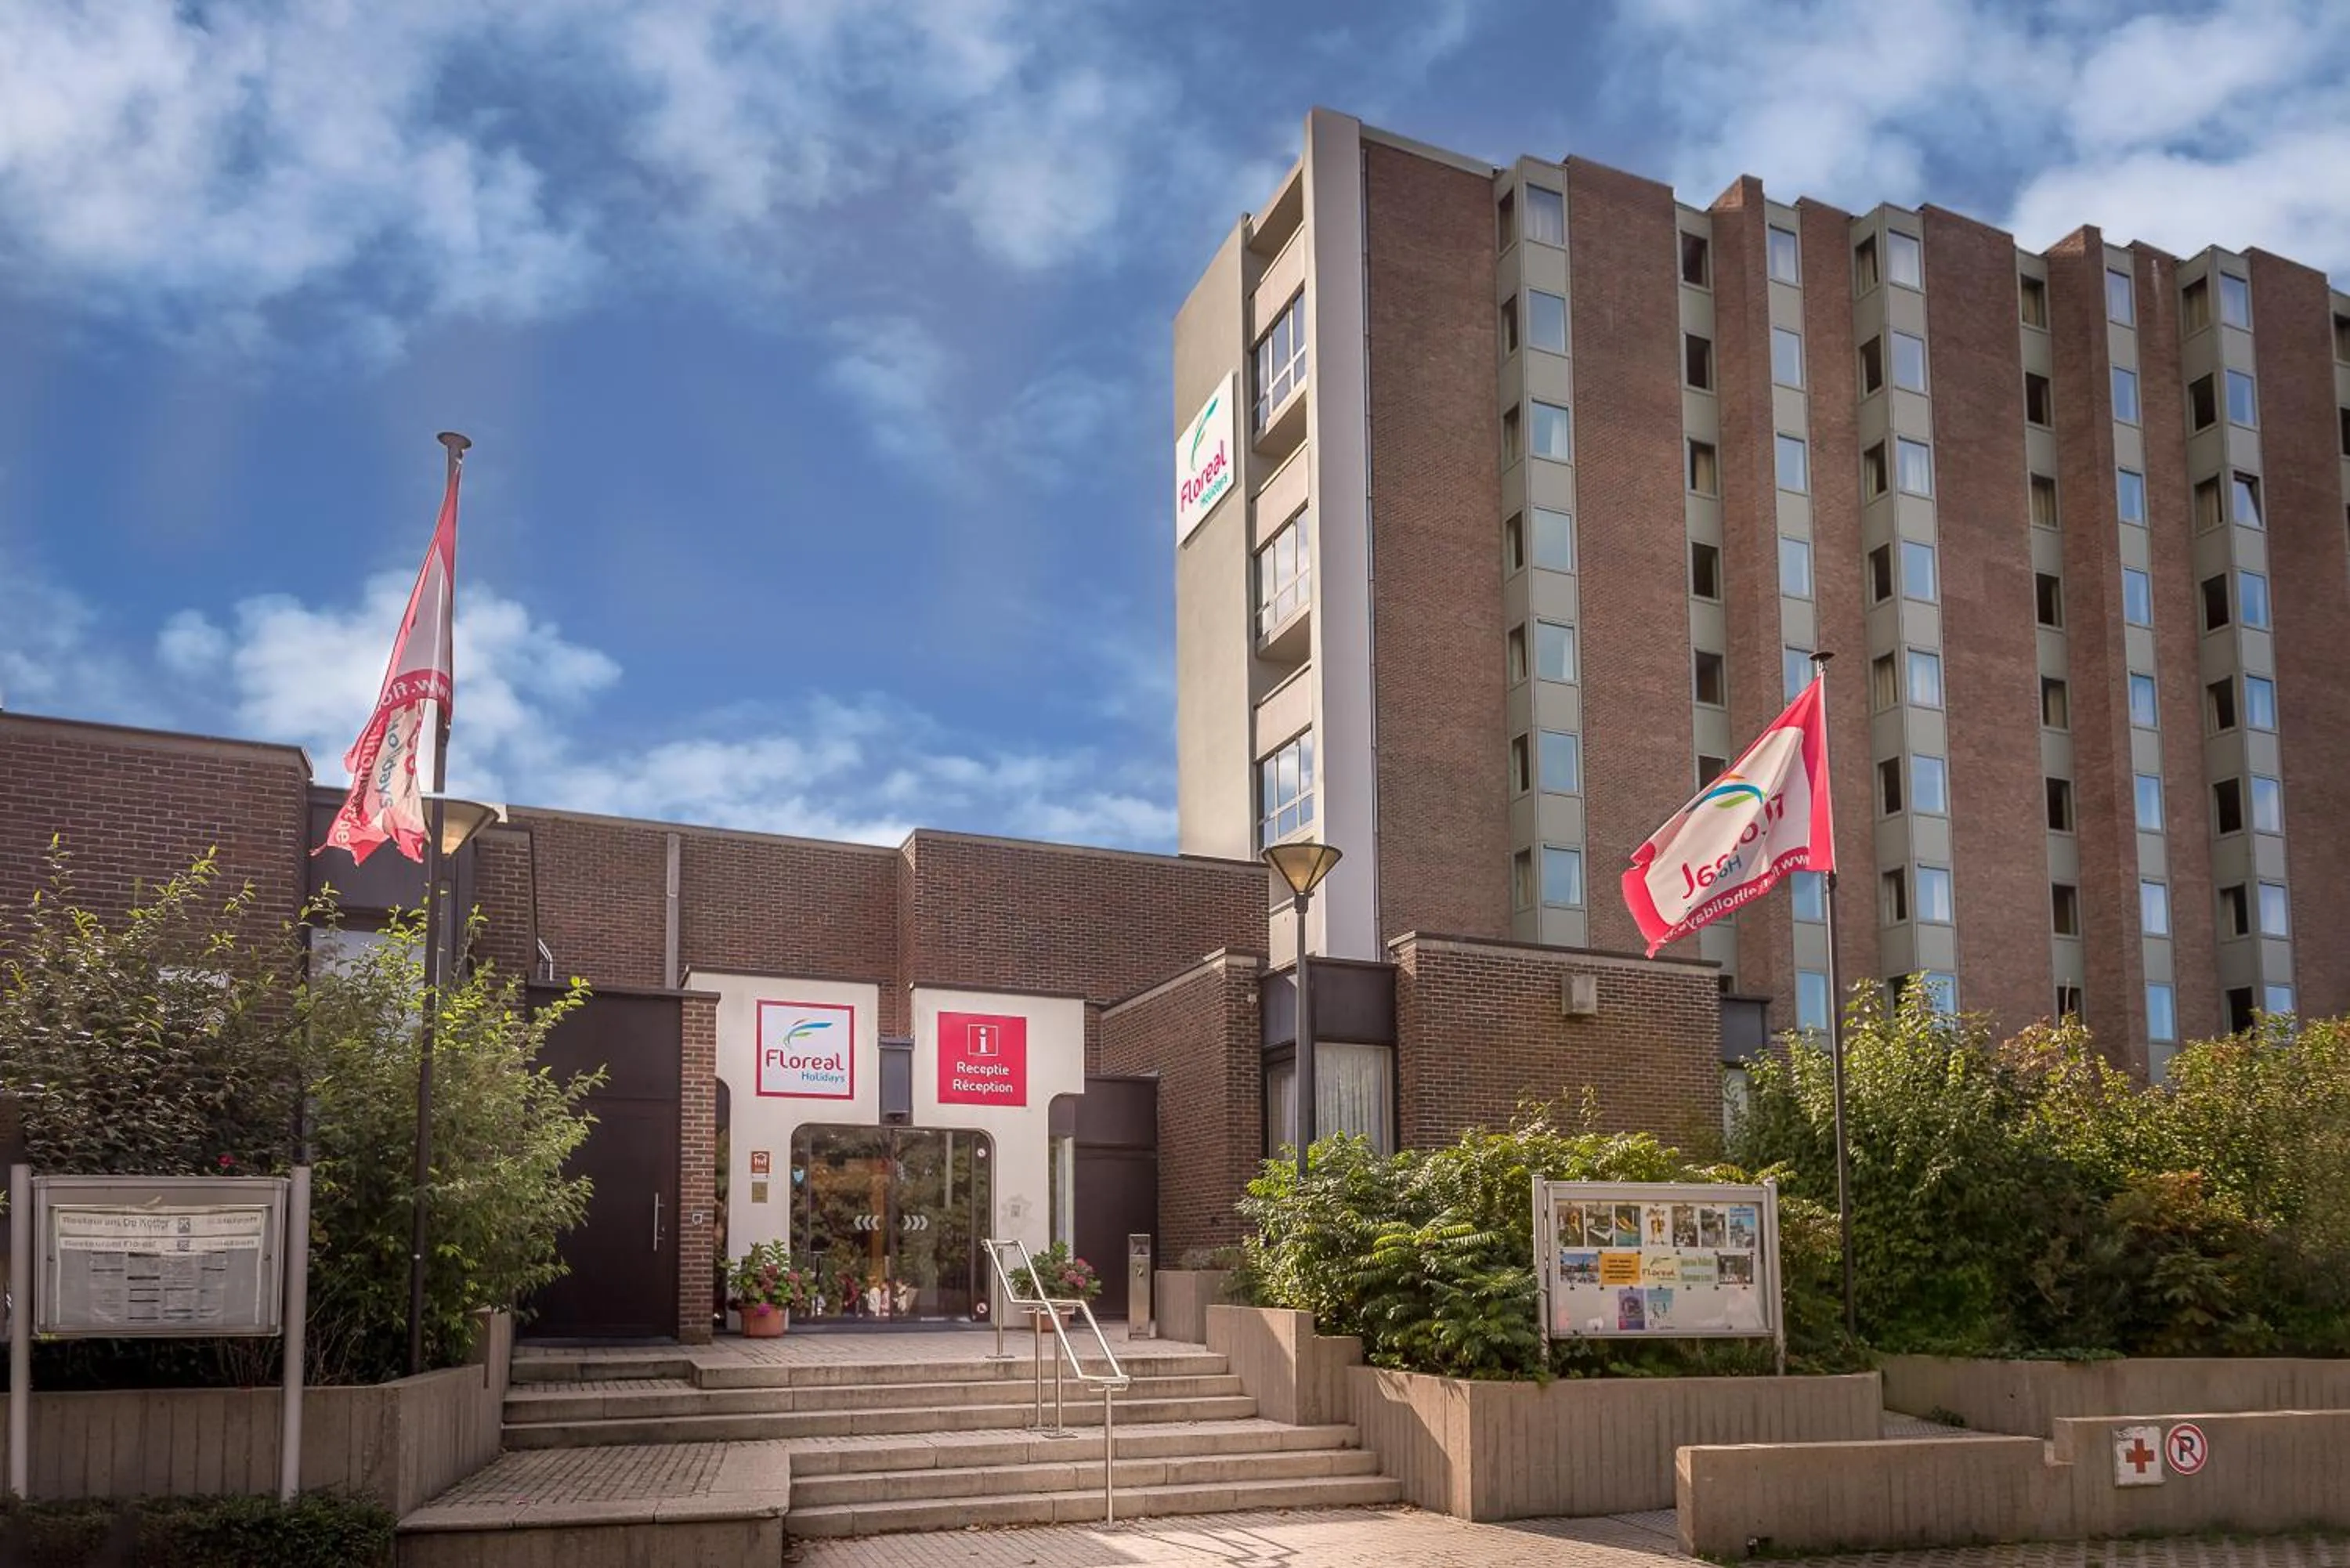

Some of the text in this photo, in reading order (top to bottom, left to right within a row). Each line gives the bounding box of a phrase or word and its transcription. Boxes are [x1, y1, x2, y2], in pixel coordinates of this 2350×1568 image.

[1181, 439, 1227, 512] Floreal
[766, 1049, 845, 1071] Floreal
[801, 1071, 846, 1083] Holidays
[956, 1061, 1010, 1077] Receptie
[953, 1078, 1014, 1095] Réception
